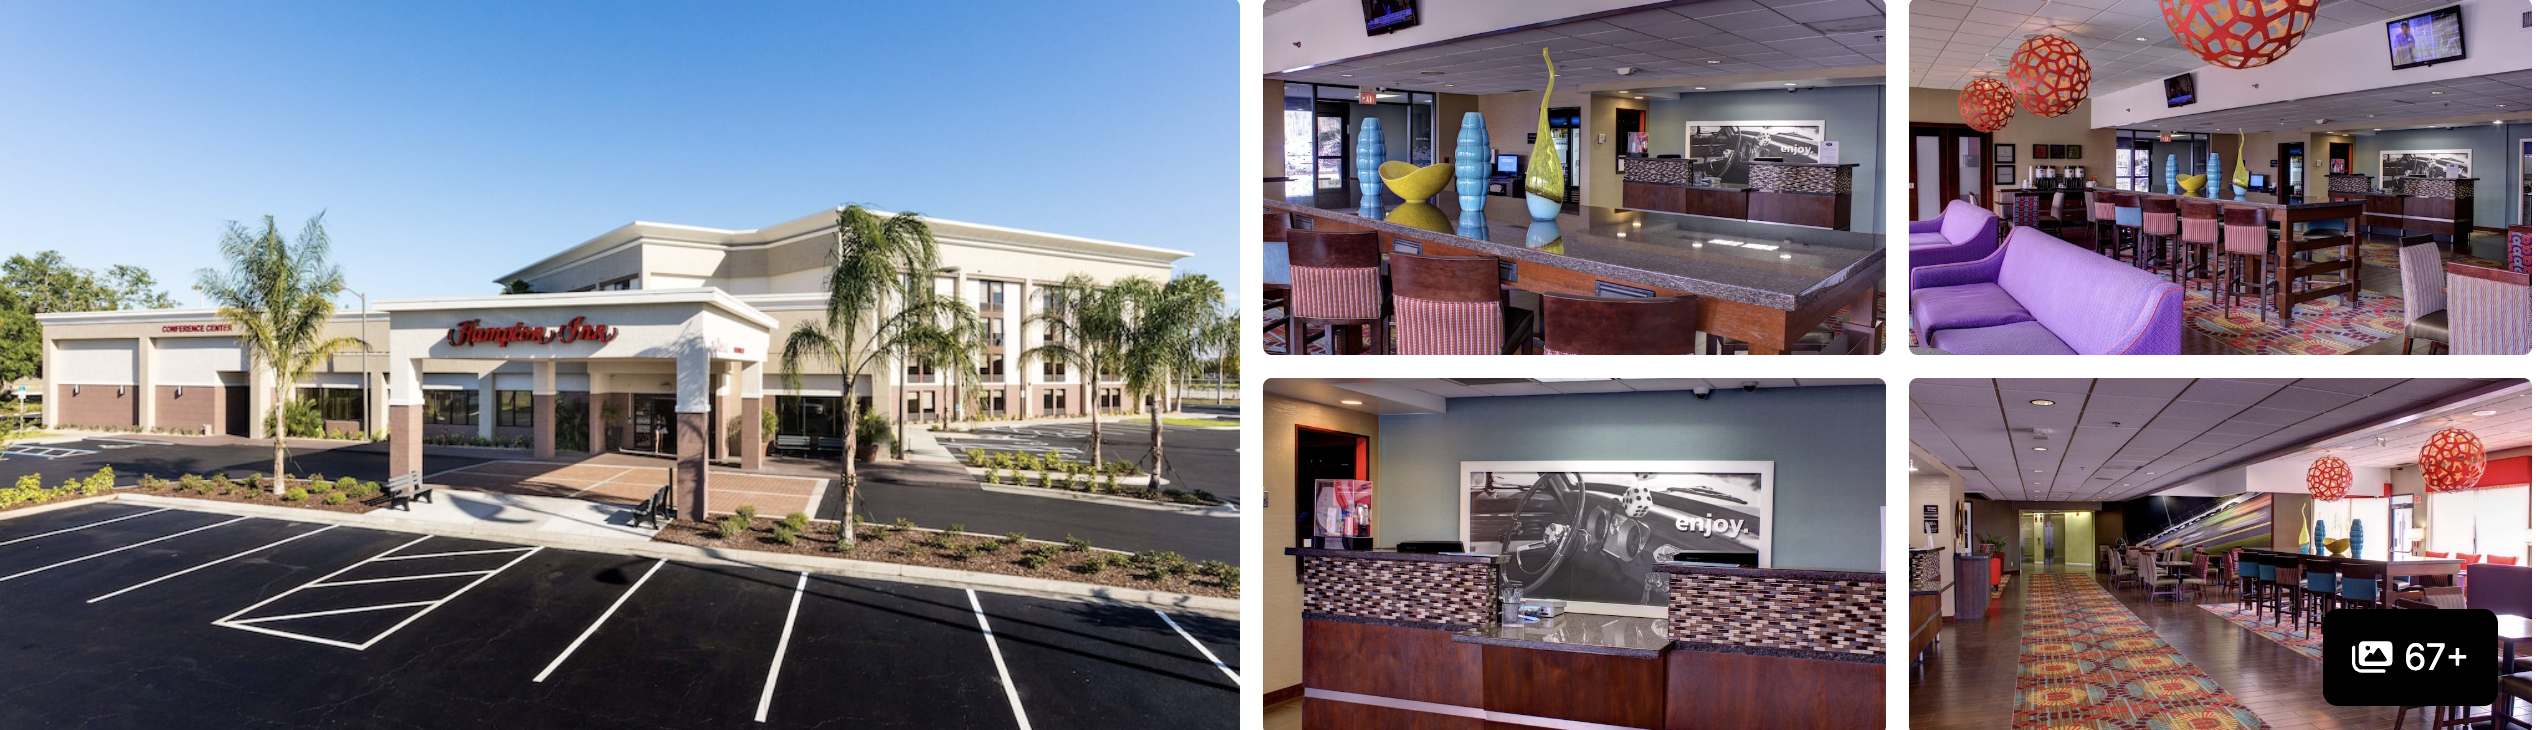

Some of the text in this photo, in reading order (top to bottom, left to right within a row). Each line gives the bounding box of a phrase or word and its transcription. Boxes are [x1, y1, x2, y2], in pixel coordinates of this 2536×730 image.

[1362, 94, 1376, 104] EXIT
[1780, 144, 1814, 155] enjoy.
[162, 323, 233, 333] CONFERENCE CENTER
[447, 315, 619, 348] Hampton Inn
[1675, 513, 1749, 538] enjoy.
